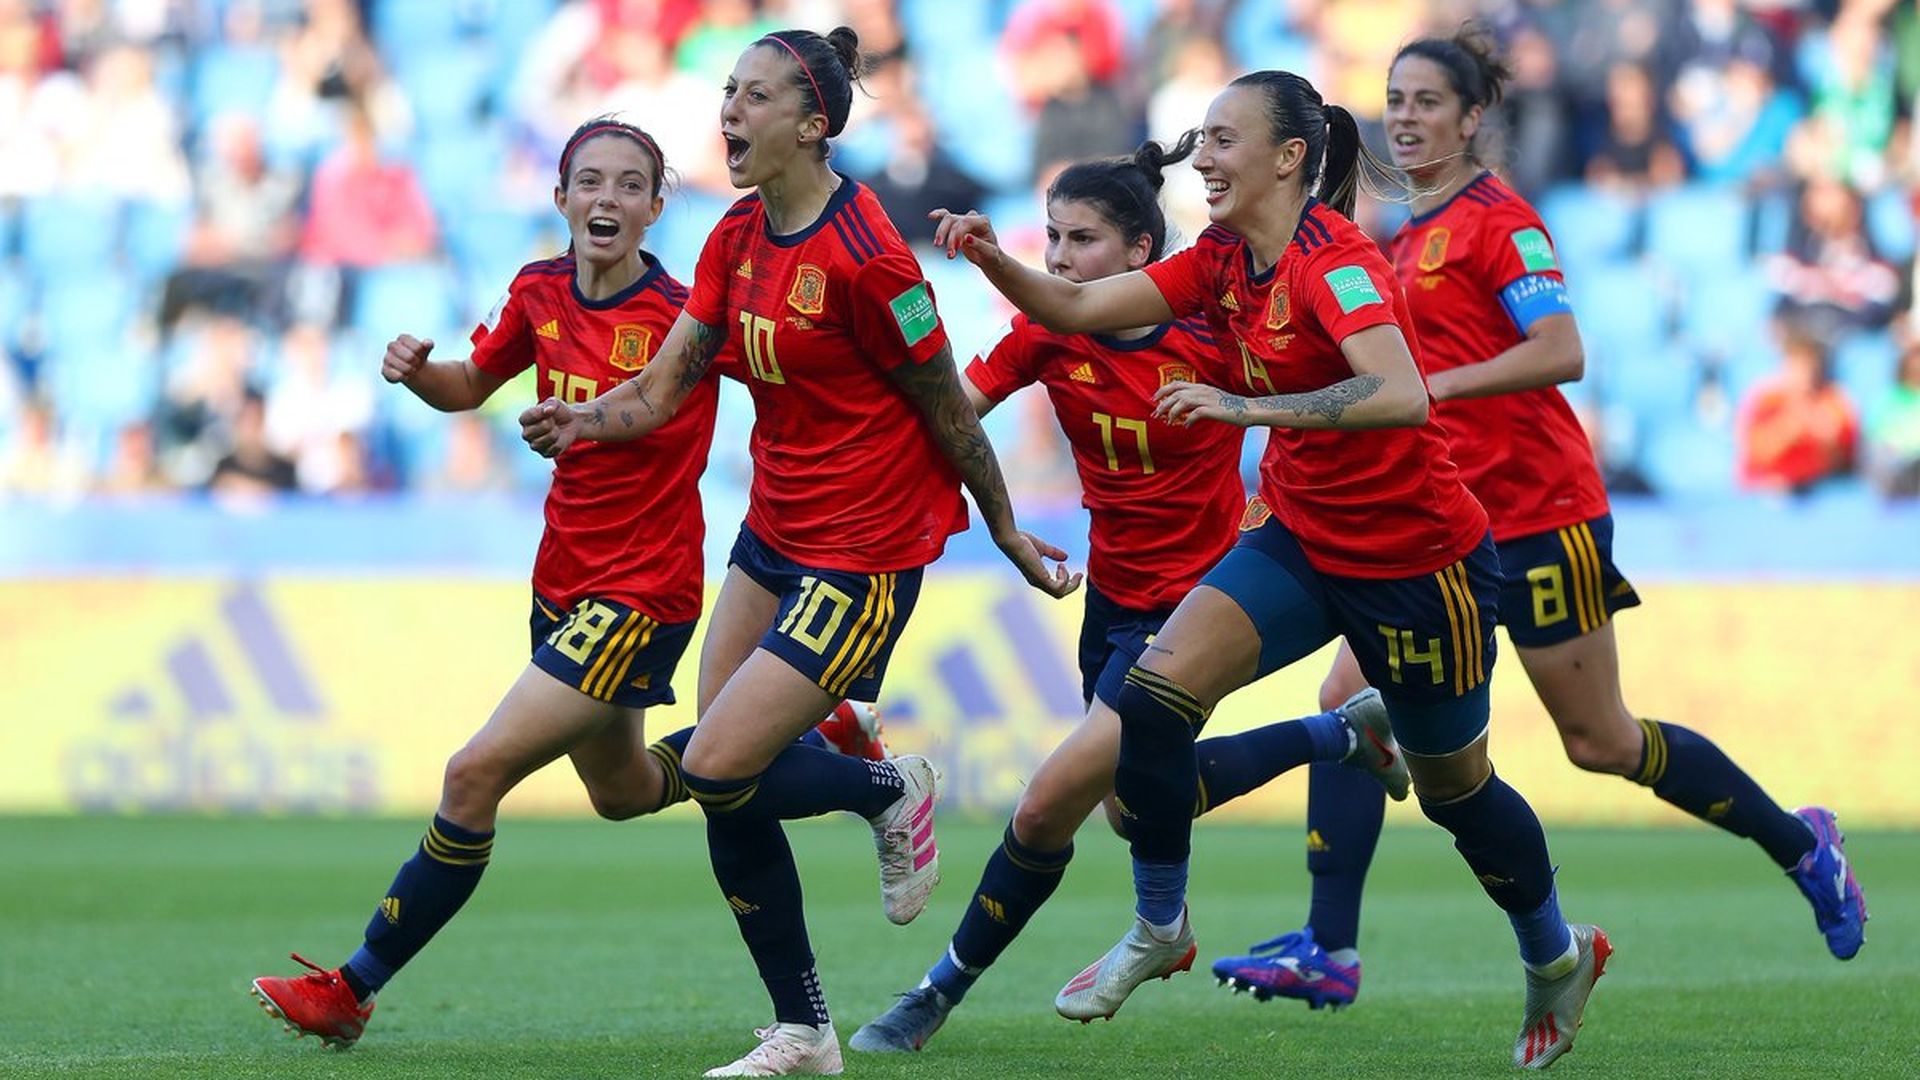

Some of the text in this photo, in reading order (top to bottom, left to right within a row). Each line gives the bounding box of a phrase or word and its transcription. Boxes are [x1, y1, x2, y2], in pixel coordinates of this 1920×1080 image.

[739, 310, 786, 385] 10
[1092, 412, 1156, 474] 17
[777, 575, 853, 656] 10
[1526, 564, 1569, 628] 8
[546, 598, 619, 666] 18
[1377, 623, 1446, 685] 14
